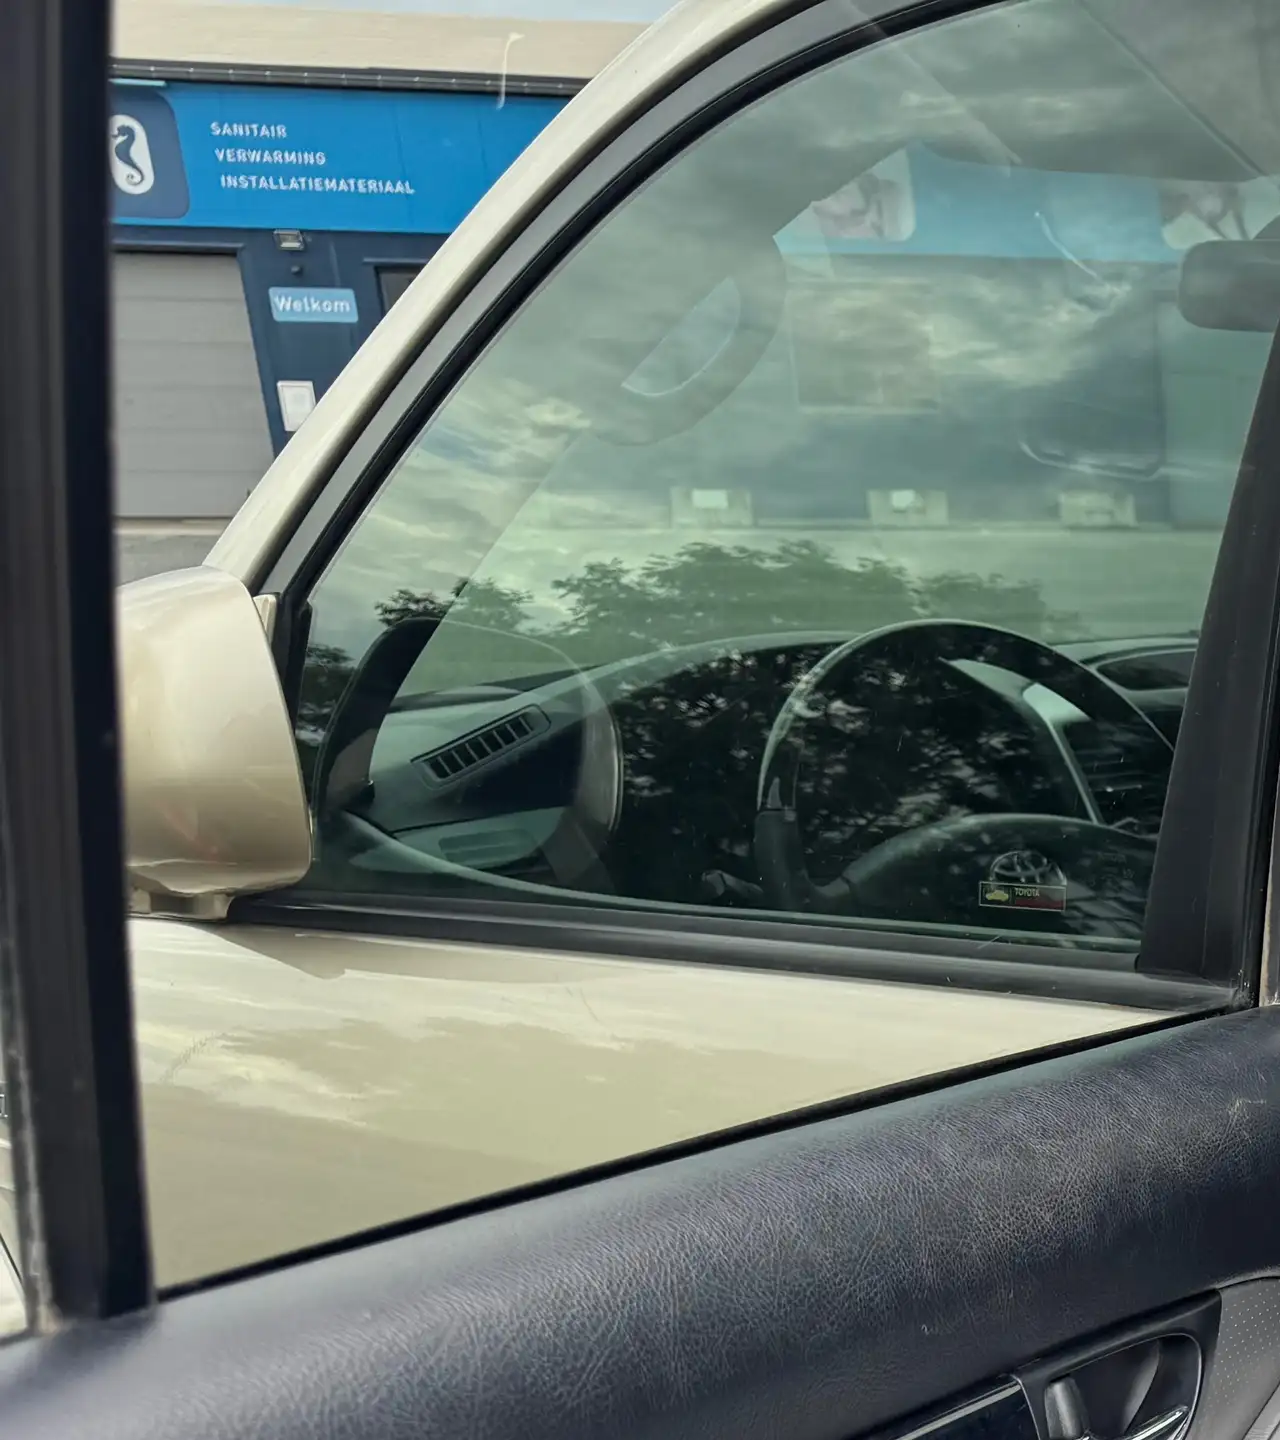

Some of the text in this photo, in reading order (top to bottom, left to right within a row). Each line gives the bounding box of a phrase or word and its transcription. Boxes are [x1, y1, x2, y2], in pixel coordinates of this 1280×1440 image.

[210, 121, 288, 138] SANITAIR
[214, 147, 327, 165] VERWARMING
[220, 174, 415, 195] INSTALLATIEMATERIAAL
[273, 295, 350, 314] Welkom
[1015, 888, 1040, 898] TOYOTA
